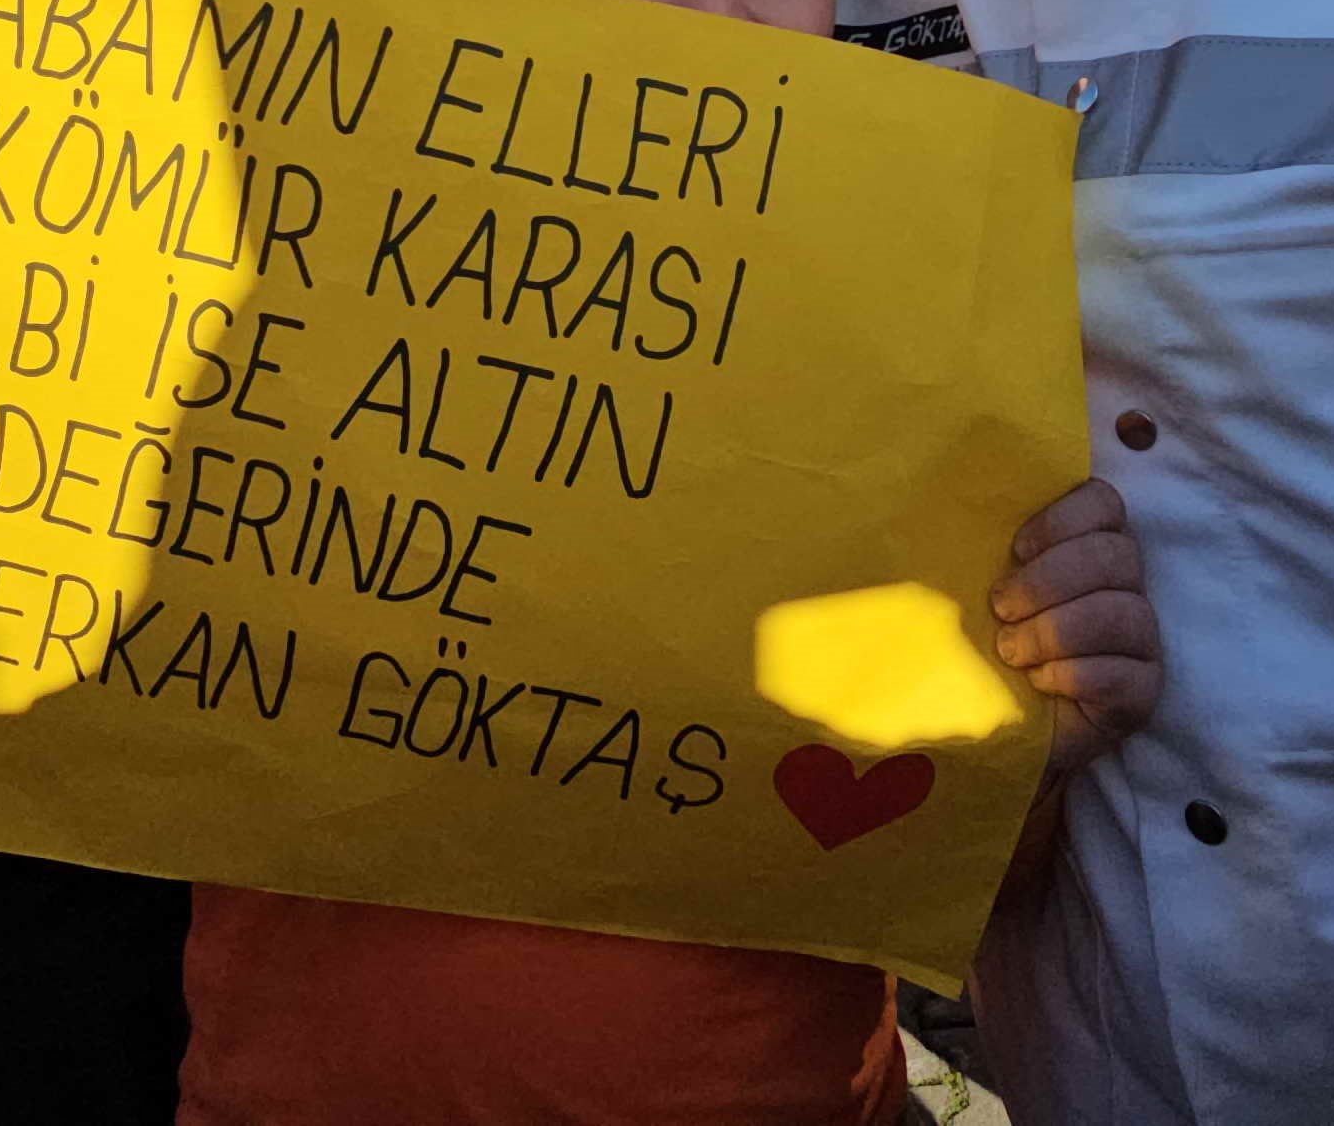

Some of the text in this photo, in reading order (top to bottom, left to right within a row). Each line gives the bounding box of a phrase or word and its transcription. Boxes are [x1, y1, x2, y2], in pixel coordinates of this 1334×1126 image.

[415, 38, 790, 216] ELLERİ
[365, 188, 746, 366] KARASI
[145, 273, 305, 431] İSE
[330, 338, 673, 499] ALTIN
[337, 636, 727, 817] GÖKTAŞ
